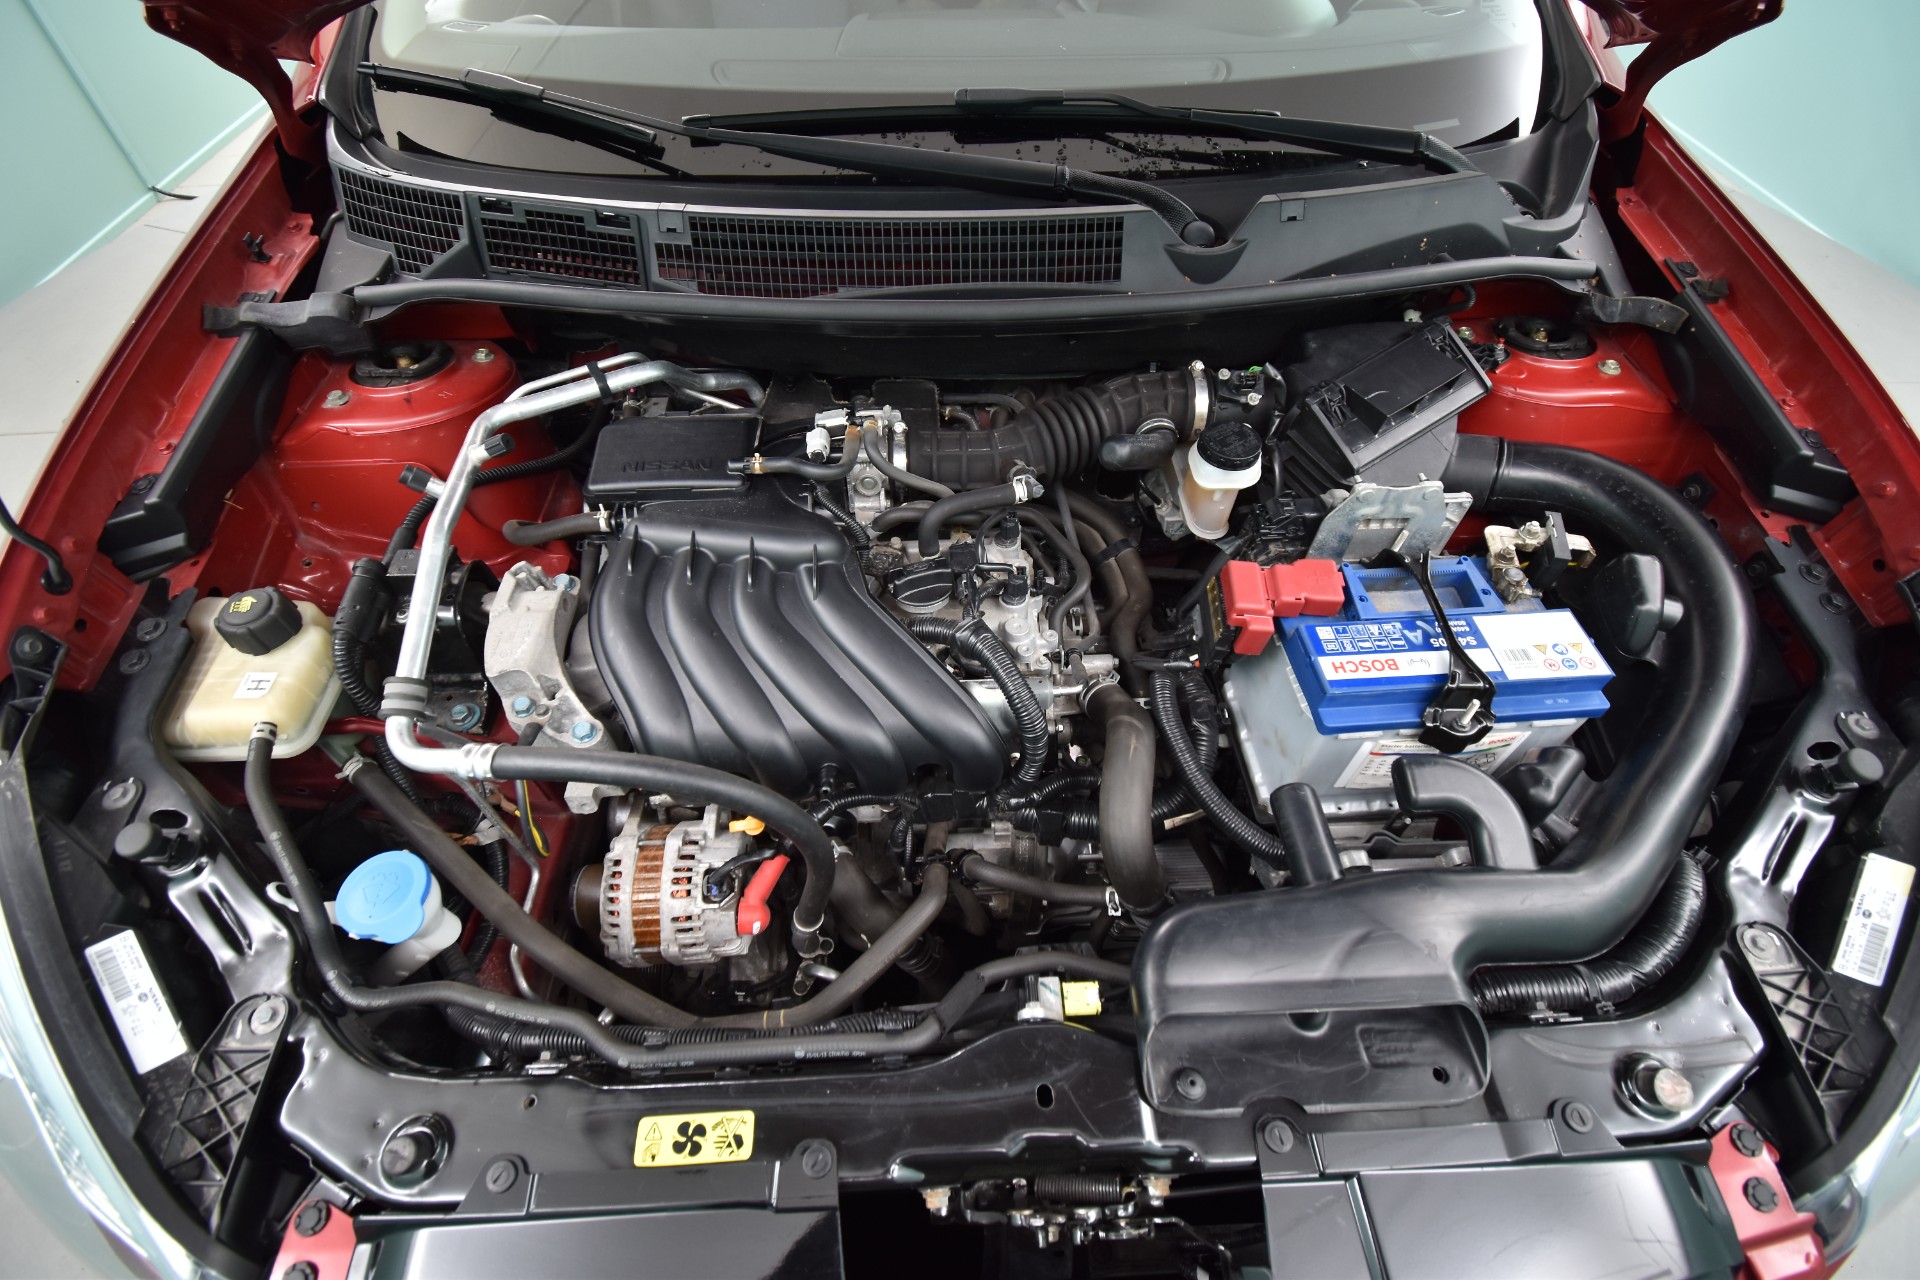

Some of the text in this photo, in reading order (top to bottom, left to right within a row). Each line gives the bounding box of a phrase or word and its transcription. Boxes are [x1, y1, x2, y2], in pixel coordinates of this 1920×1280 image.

[622, 457, 713, 473] NISSAN
[1457, 636, 1478, 646] S4
[1331, 658, 1400, 674] BOSCH
[1487, 736, 1517, 746] BOSCH
